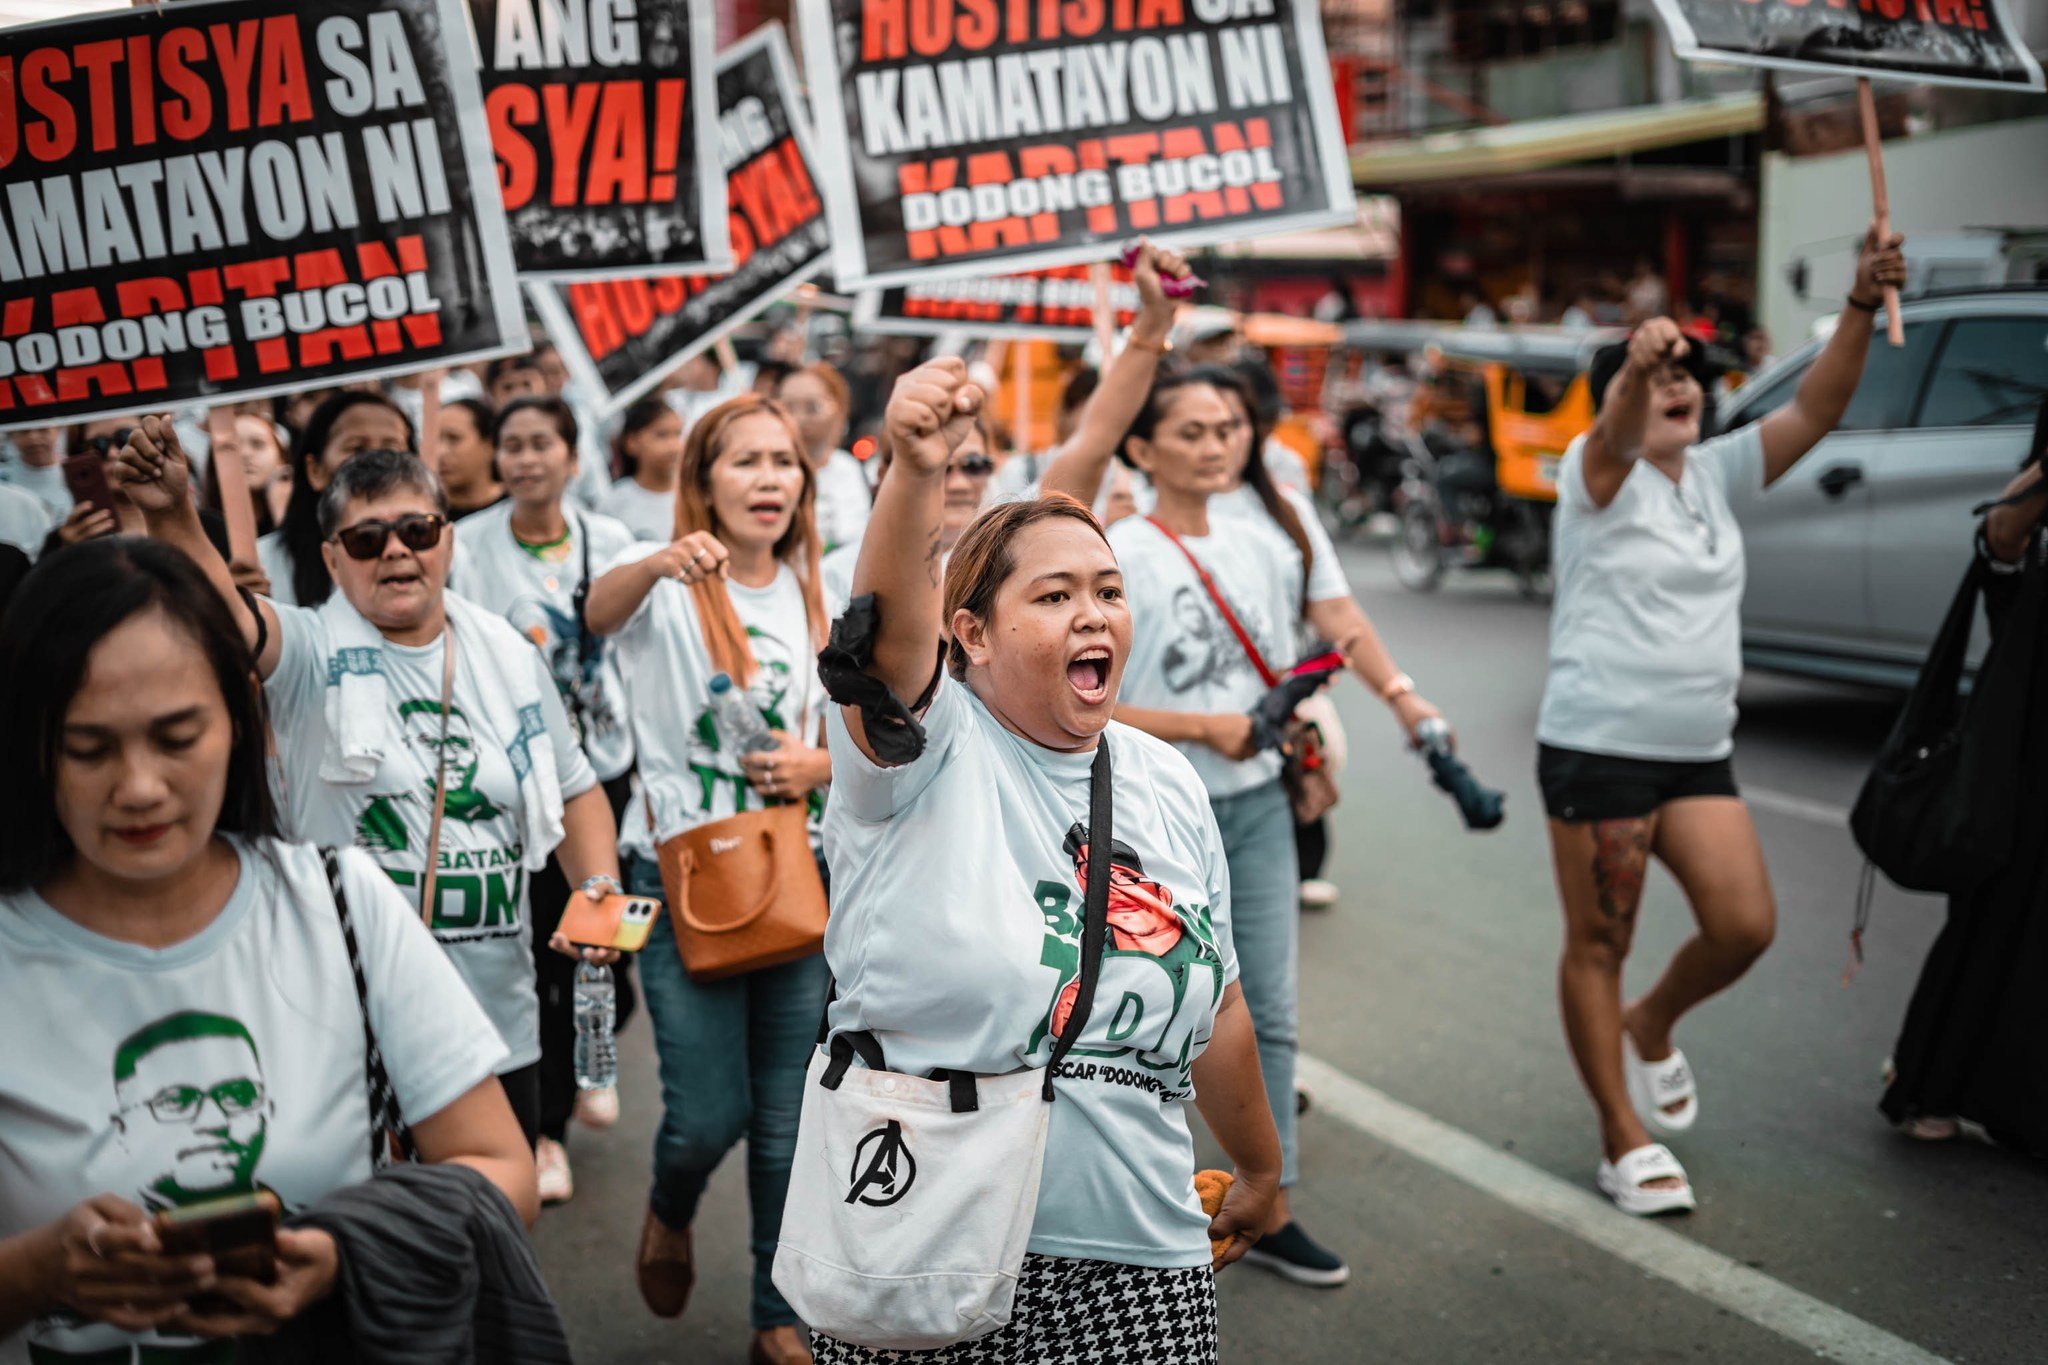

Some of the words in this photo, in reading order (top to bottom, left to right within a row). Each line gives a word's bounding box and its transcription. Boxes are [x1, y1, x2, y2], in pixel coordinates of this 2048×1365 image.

[316, 10, 429, 117] SA
[494, 0, 642, 71] ANG
[855, 30, 1219, 157] KAMATAYON
[1217, 23, 1293, 110] NI
[361, 117, 452, 223] NI
[897, 117, 1284, 261] KAPITAN
[902, 168, 1114, 232] DODONG
[1116, 146, 1283, 204] BUCOL
[240, 270, 442, 342] BUCOL
